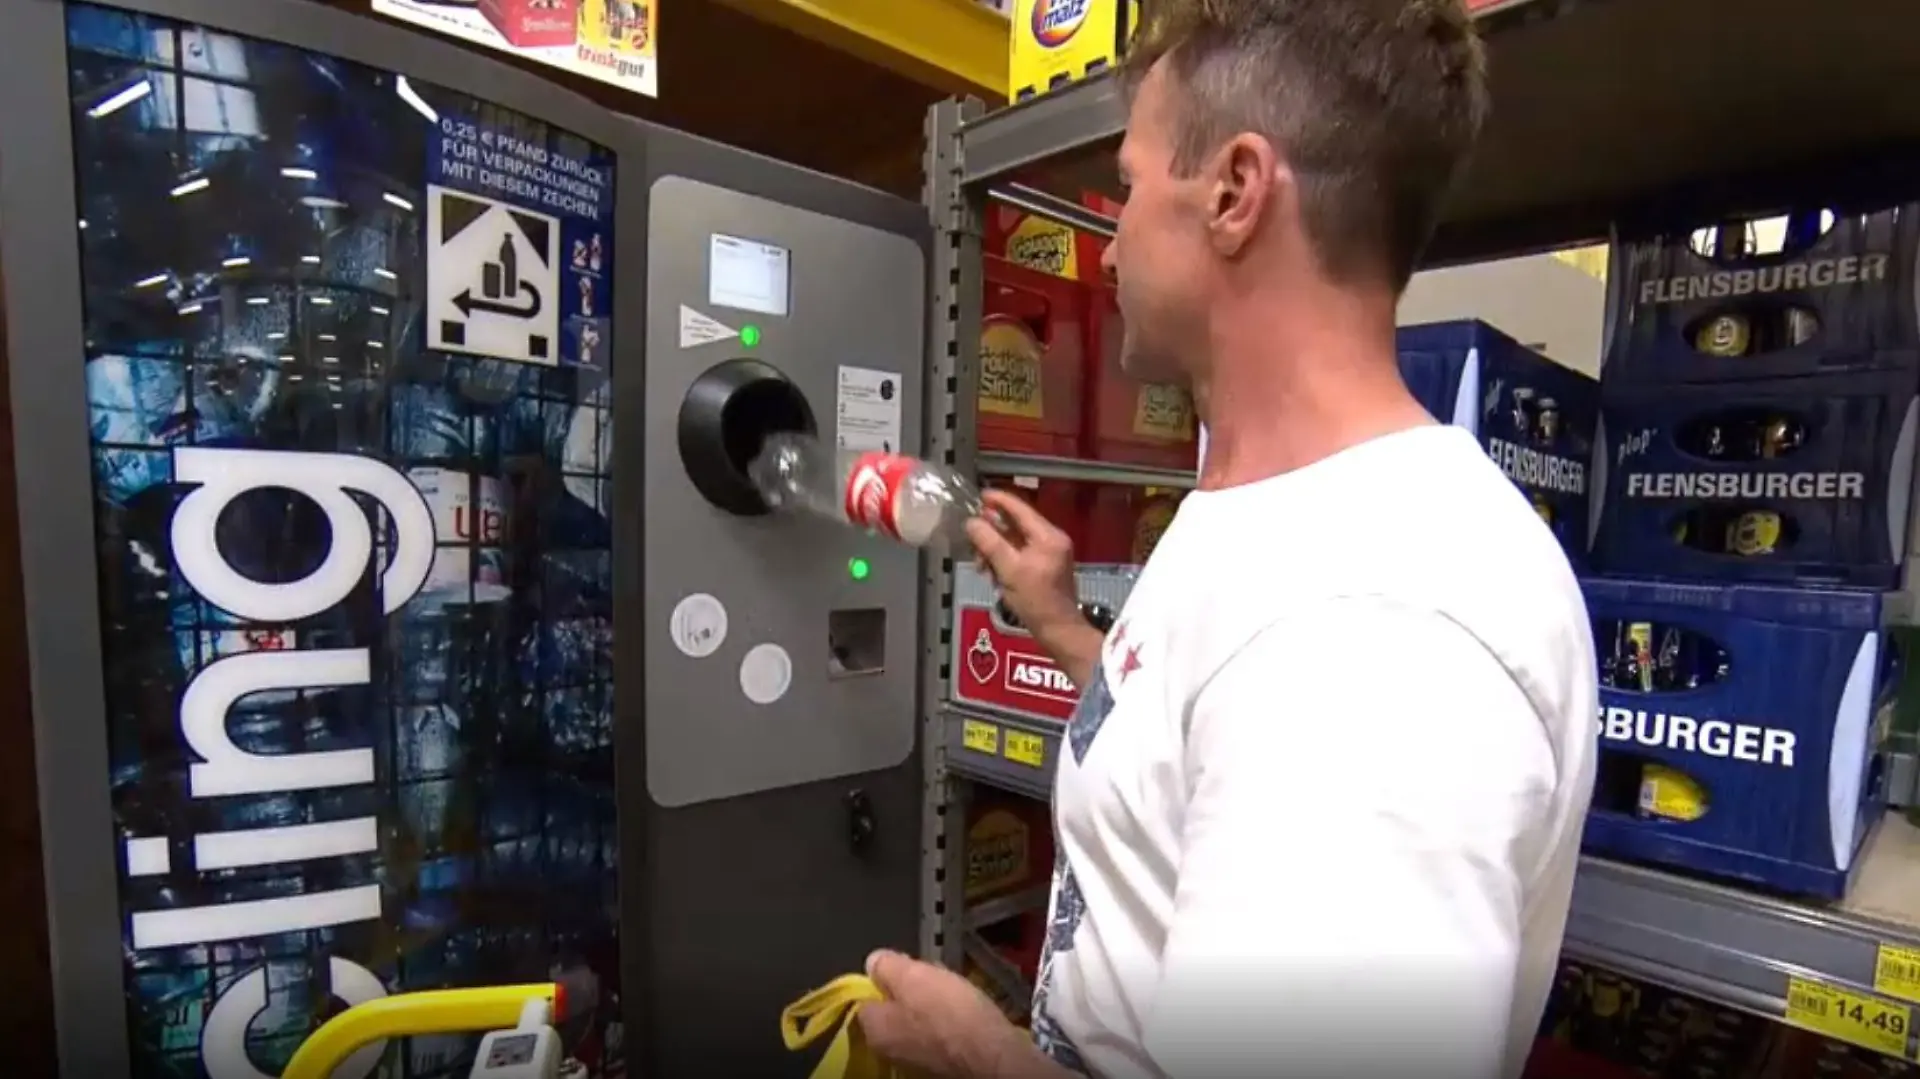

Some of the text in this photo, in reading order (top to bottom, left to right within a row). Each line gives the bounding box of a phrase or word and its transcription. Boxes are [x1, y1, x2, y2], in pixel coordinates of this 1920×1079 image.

[577, 44, 645, 78] trinkgut
[441, 137, 599, 201] FÜR VERPACKUNGEN
[497, 134, 548, 164] PFAND
[441, 159, 599, 221] MIT DIESEM ZEICHEN
[1639, 253, 1889, 304] FLENSBURGER
[1490, 437, 1584, 495] FLENSBURGER
[1627, 472, 1865, 498] FLENSBURGER
[1835, 999, 1905, 1035] 14,49
